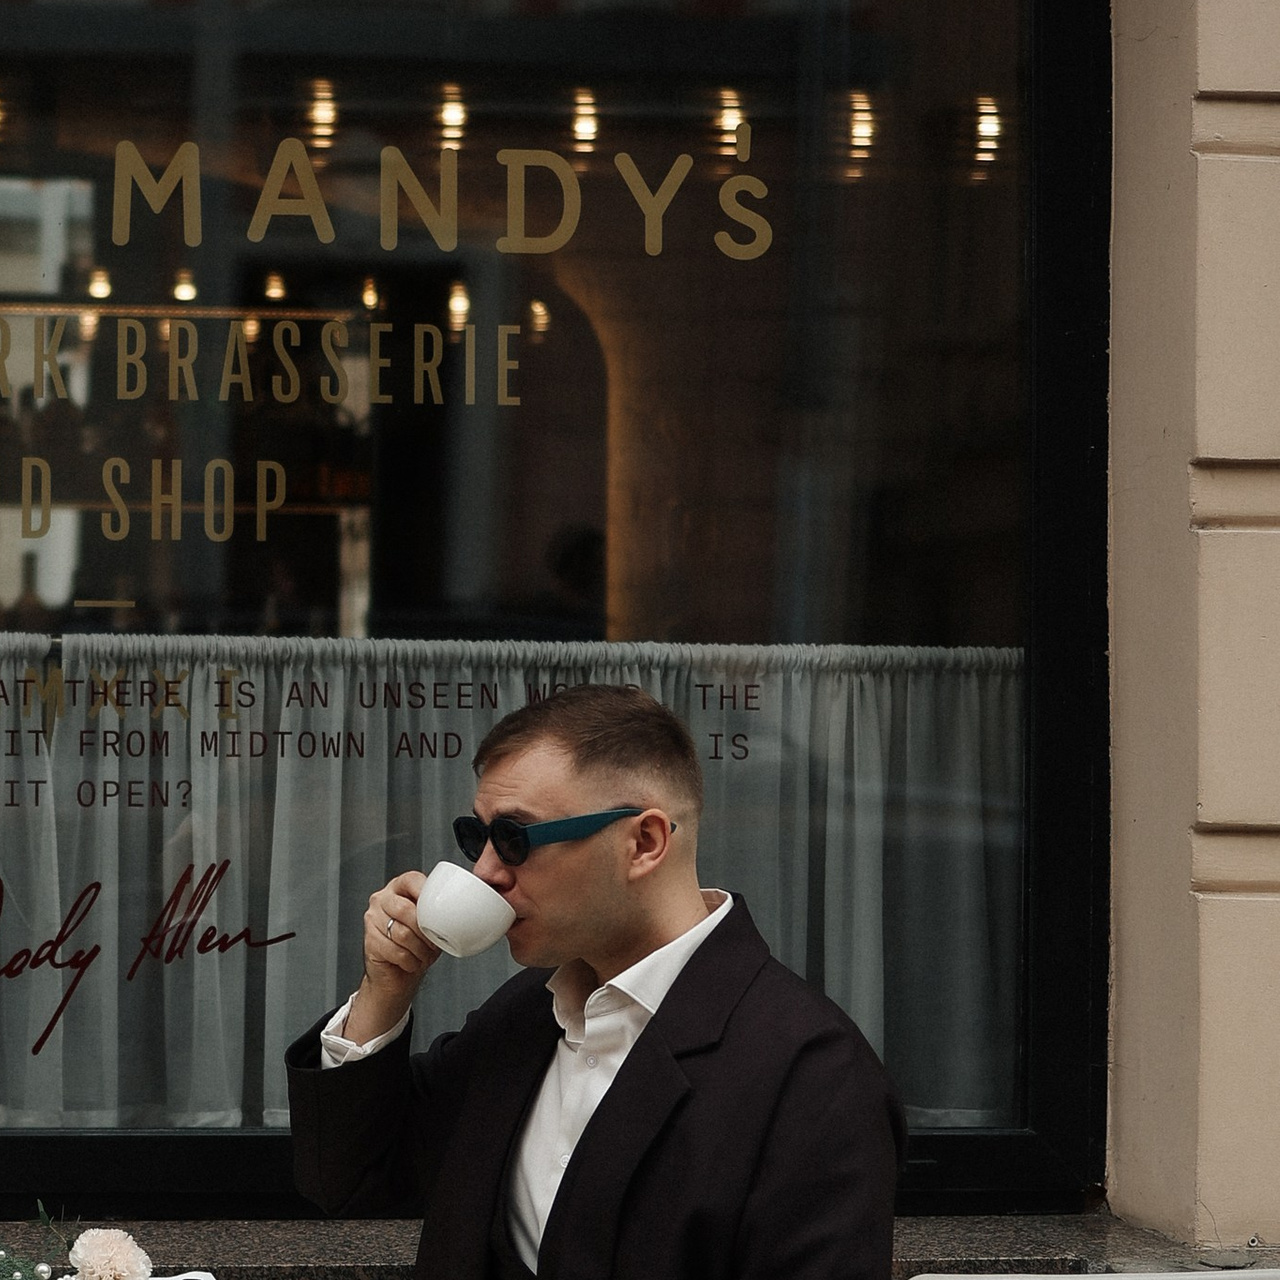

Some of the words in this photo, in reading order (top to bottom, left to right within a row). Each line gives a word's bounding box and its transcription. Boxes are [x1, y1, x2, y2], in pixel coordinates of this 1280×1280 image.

[116, 318, 522, 407] BRASSERIE
[100, 456, 288, 543] SHOP
[64, 680, 182, 708] THERE
[213, 681, 256, 708] IS
[285, 681, 330, 709] AN
[359, 682, 500, 710] UNSEEN
[694, 683, 761, 711] THE
[4, 730, 48, 757] IT
[79, 730, 170, 758] FROM
[199, 731, 367, 759] MIDTOWN
[394, 732, 463, 759] AND
[708, 733, 750, 761] IS
[4, 779, 49, 807] IT
[77, 779, 193, 808] OPEN?
[126, 858, 297, 981] Allen
